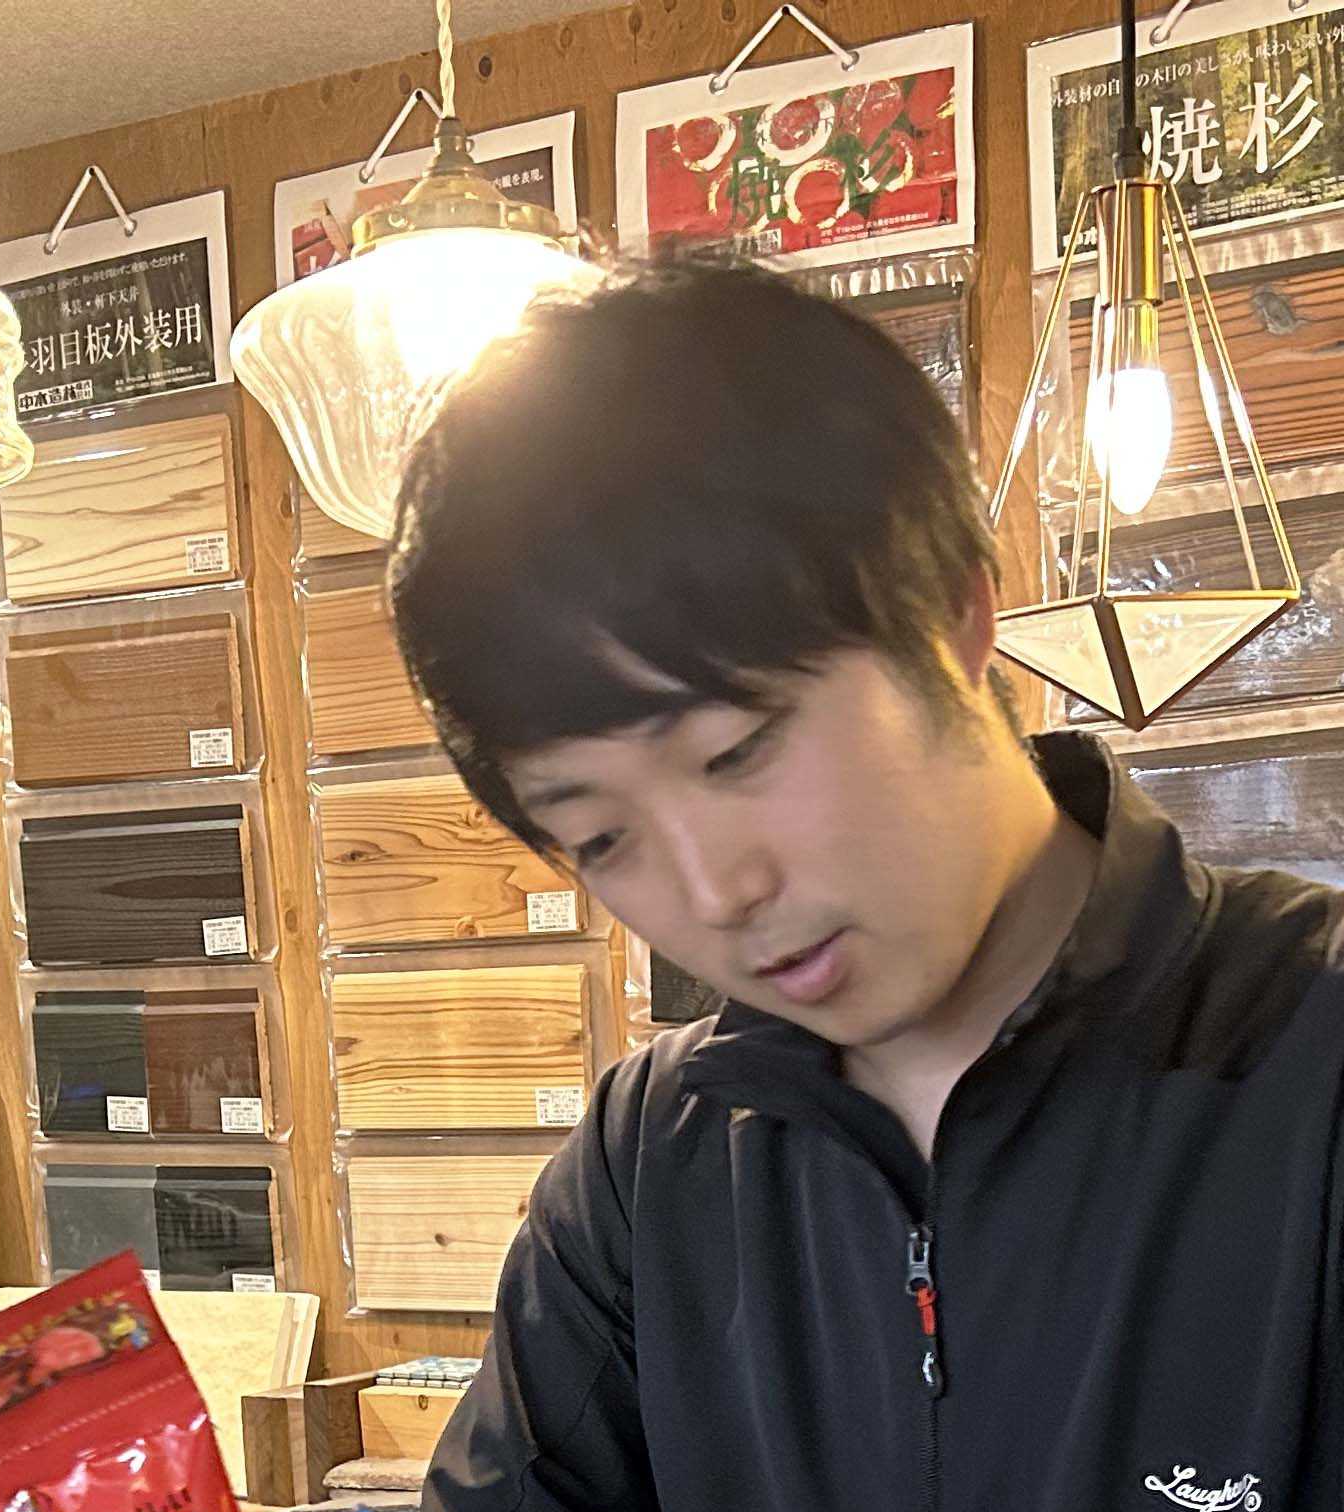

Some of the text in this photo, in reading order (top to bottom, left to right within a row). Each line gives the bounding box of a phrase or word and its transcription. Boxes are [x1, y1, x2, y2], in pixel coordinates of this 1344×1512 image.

[1142, 73, 1324, 185] 焼杉
[22, 303, 201, 376] 羽目板外装用
